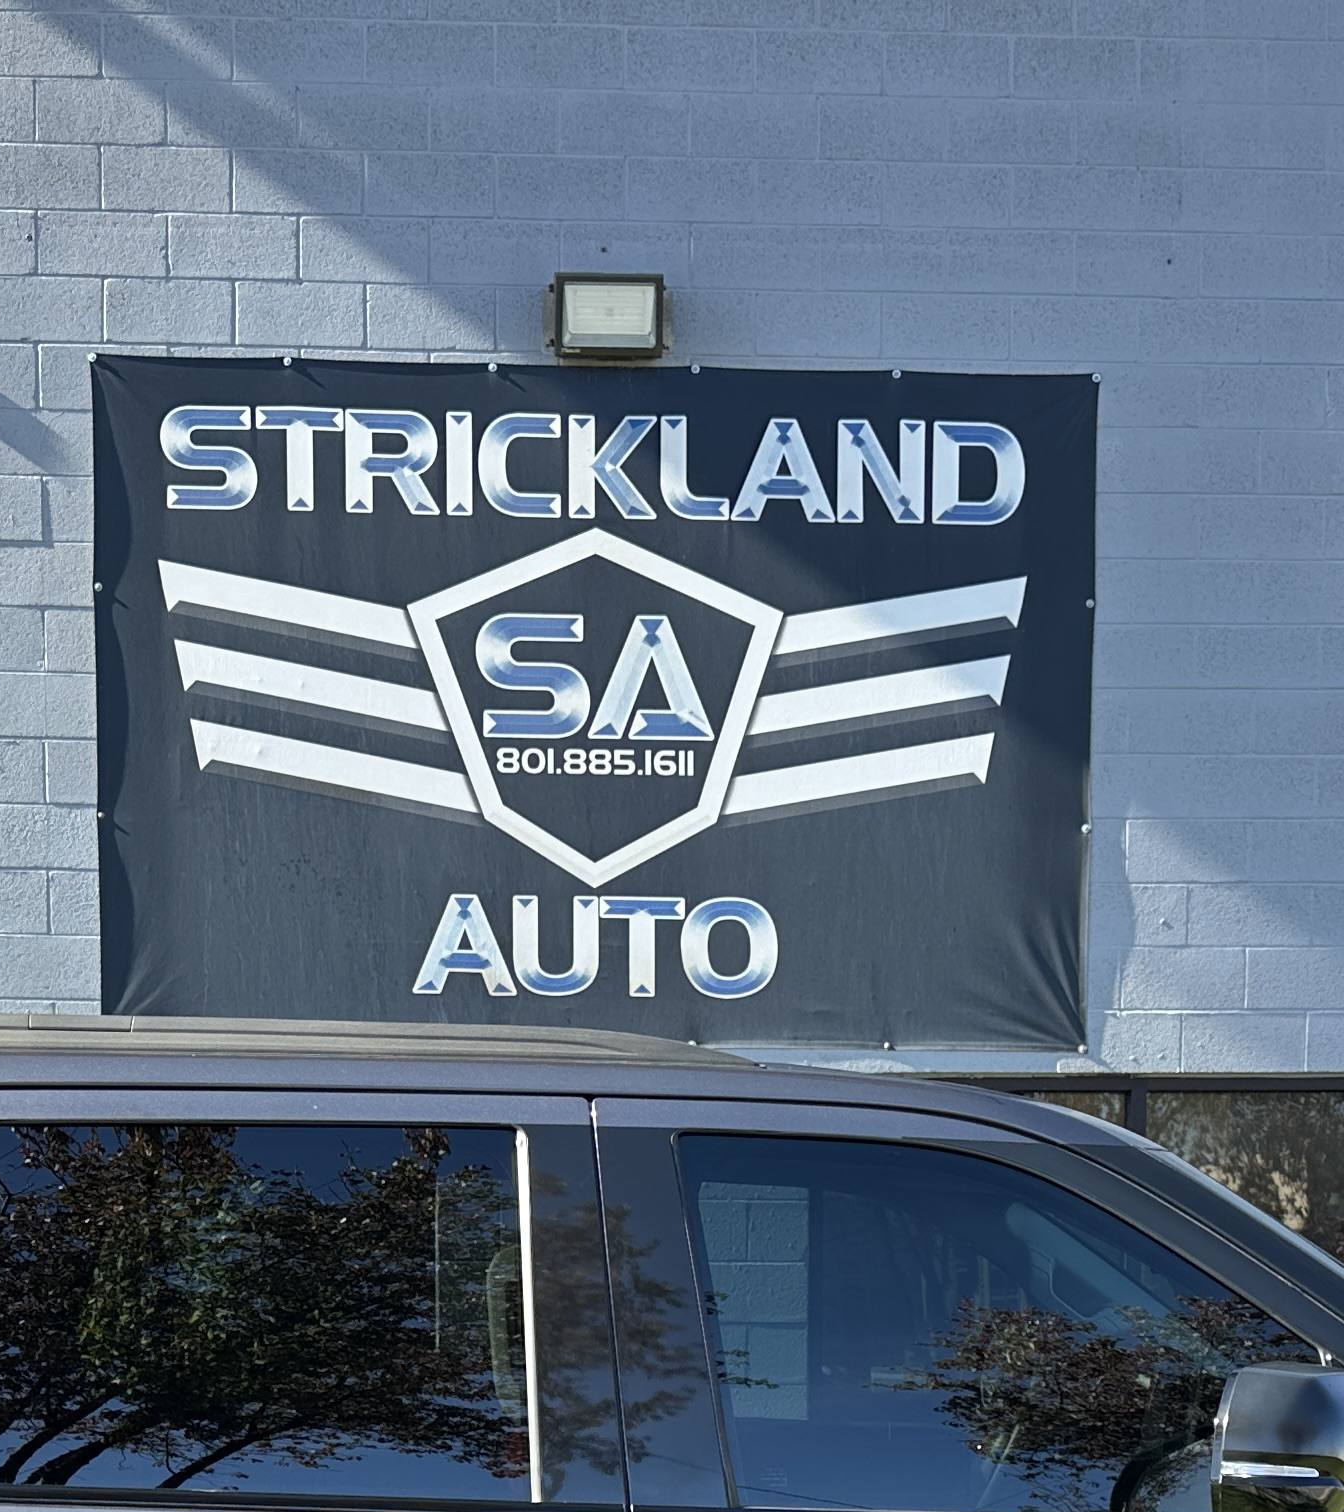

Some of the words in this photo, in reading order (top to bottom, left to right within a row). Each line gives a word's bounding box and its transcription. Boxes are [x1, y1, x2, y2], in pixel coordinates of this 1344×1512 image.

[158, 403, 1027, 527] STRICKLAND
[473, 611, 717, 743] SA
[496, 746, 695, 777] 801.885.1611
[410, 892, 780, 1001] AUTO
